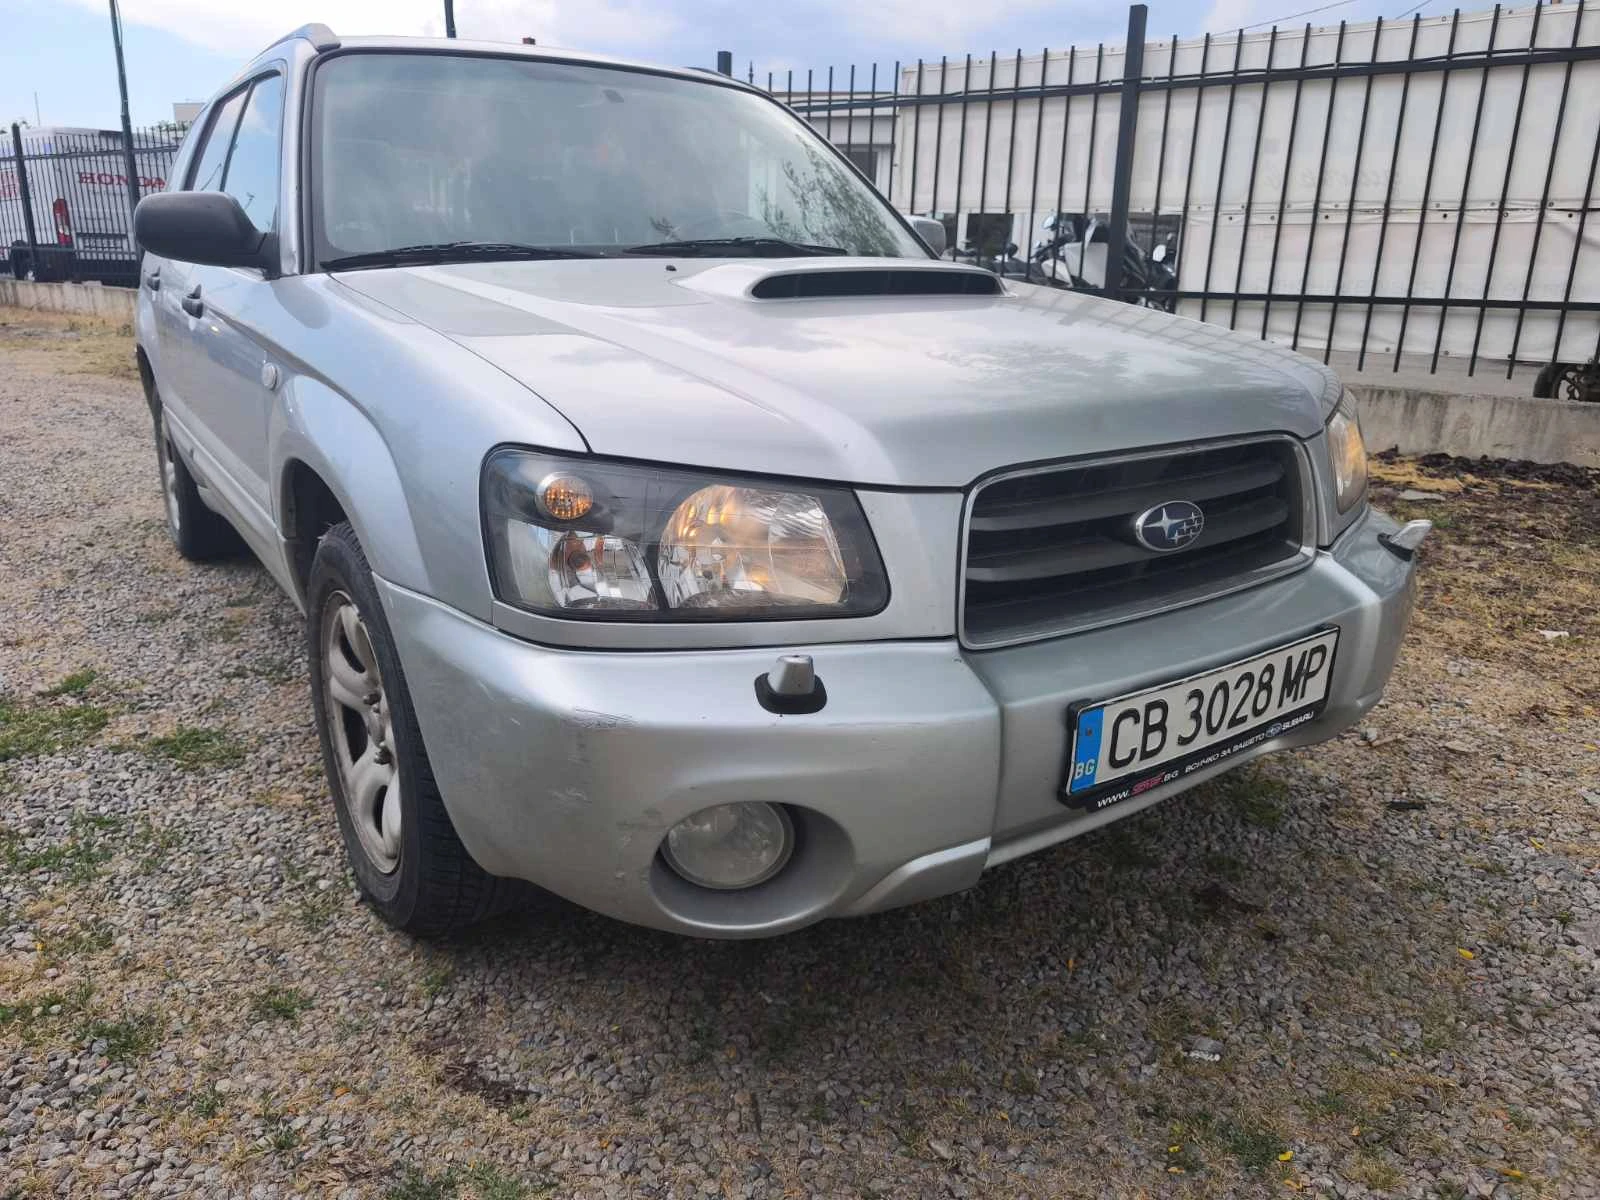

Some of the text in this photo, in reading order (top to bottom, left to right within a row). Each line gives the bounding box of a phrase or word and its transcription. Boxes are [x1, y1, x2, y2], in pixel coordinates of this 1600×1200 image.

[1177, 663, 1275, 746] 3028
[1277, 644, 1327, 708] MP
[1075, 759, 1096, 779] BG
